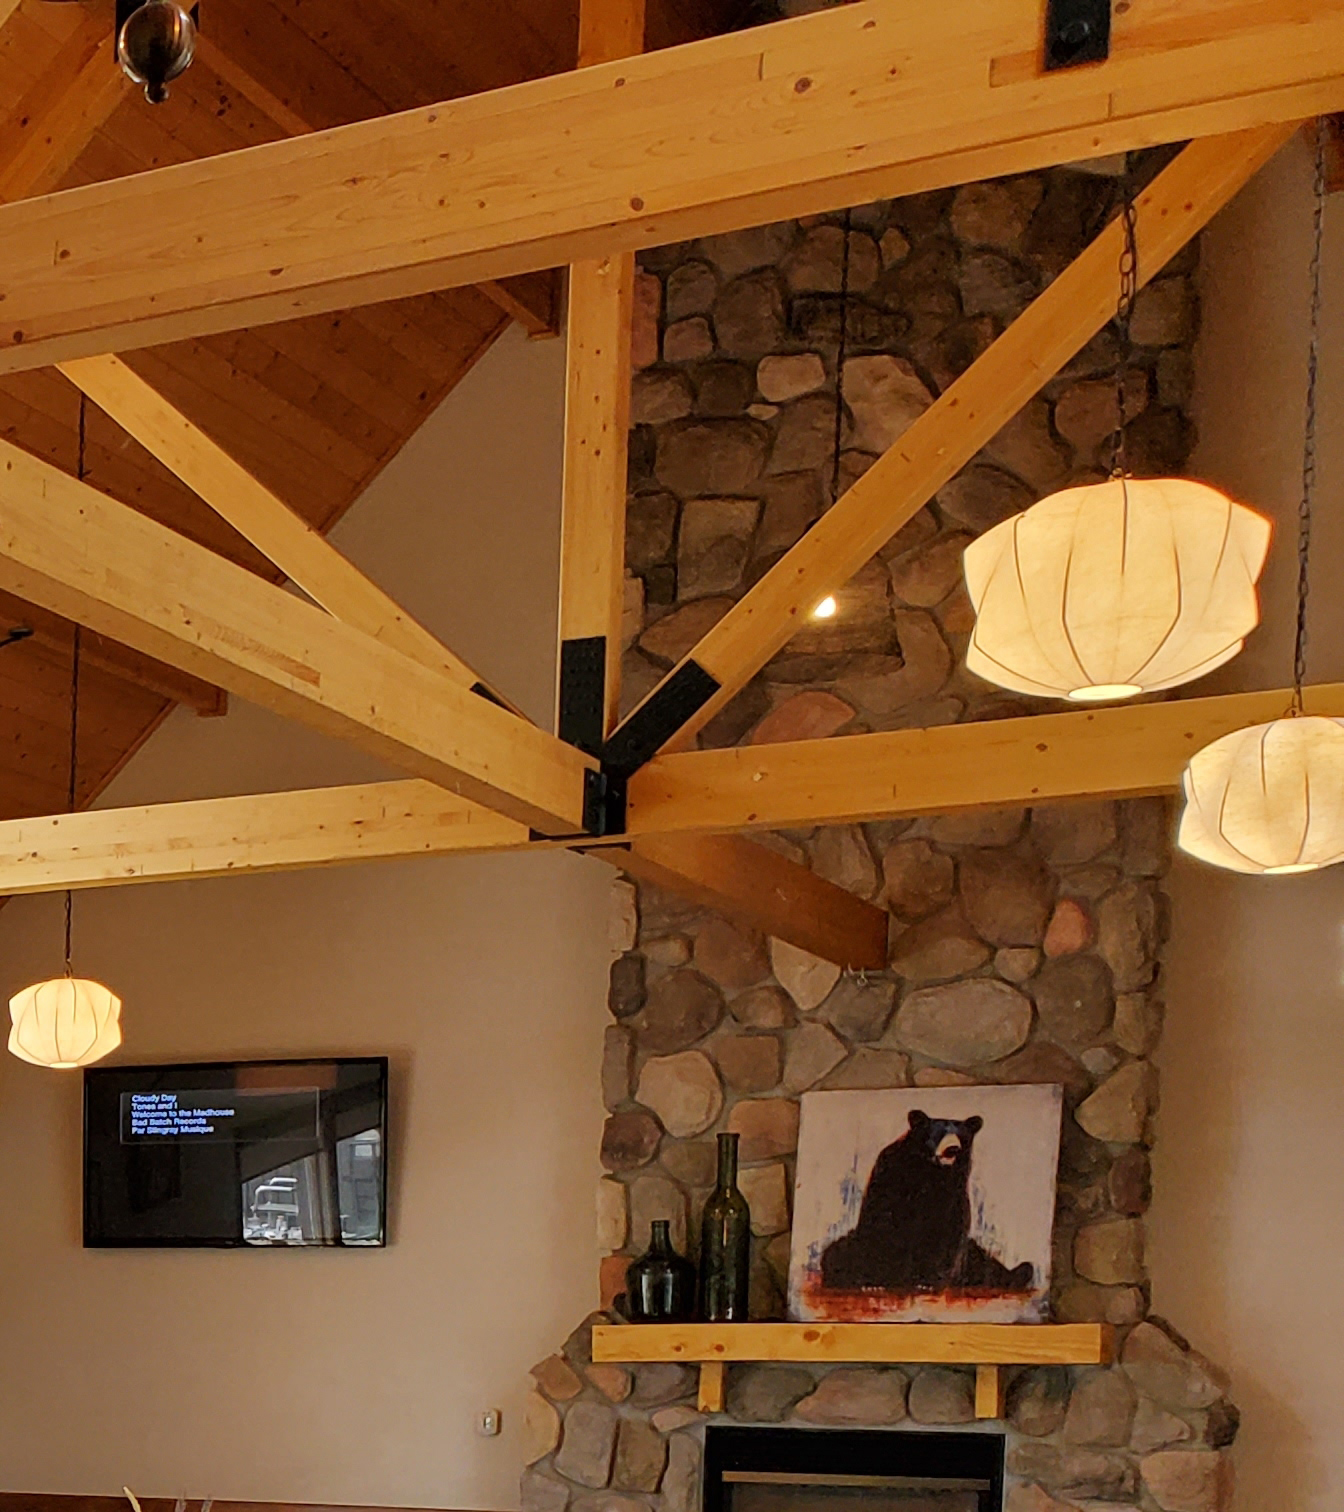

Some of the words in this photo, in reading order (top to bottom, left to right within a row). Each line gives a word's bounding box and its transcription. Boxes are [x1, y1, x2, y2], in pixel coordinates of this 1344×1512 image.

[132, 1094, 160, 1103] Cloudy
[161, 1094, 177, 1103] Day
[157, 1102, 172, 1110] and
[131, 1110, 167, 1118] Welcome
[179, 1109, 192, 1117] the
[193, 1108, 234, 1117] Madhouse
[174, 1117, 207, 1125] Records
